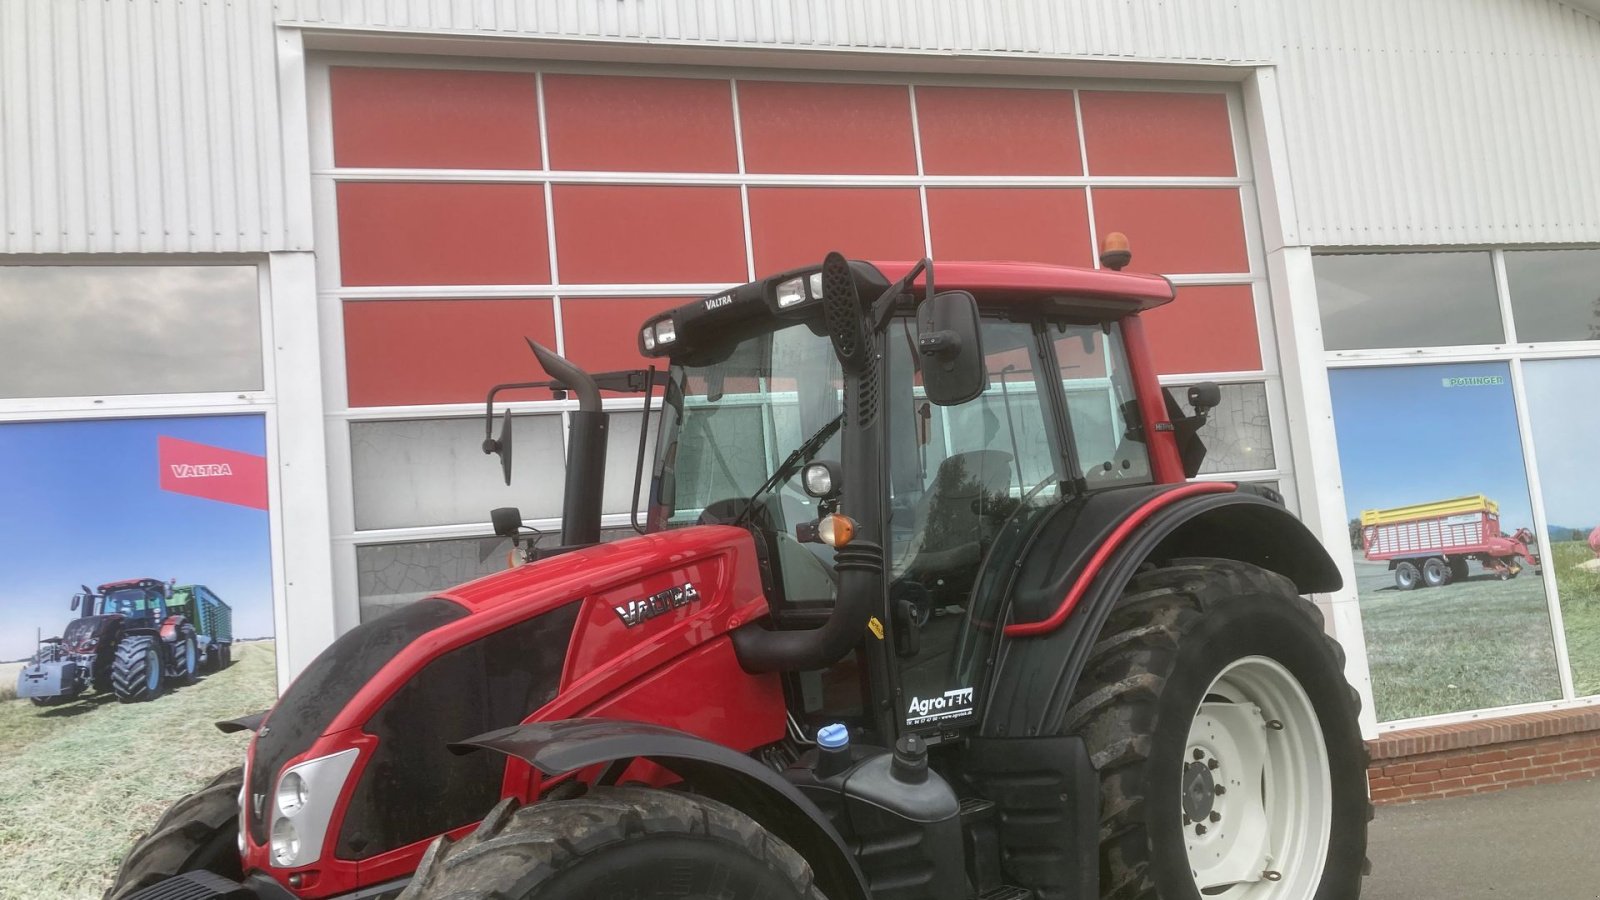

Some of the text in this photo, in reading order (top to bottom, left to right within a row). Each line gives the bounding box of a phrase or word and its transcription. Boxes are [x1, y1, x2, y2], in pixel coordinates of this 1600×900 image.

[705, 294, 732, 310] VALTRA
[170, 463, 233, 478] VALTRA
[614, 583, 699, 628] VALTRA
[908, 687, 973, 716] AgroTEK
